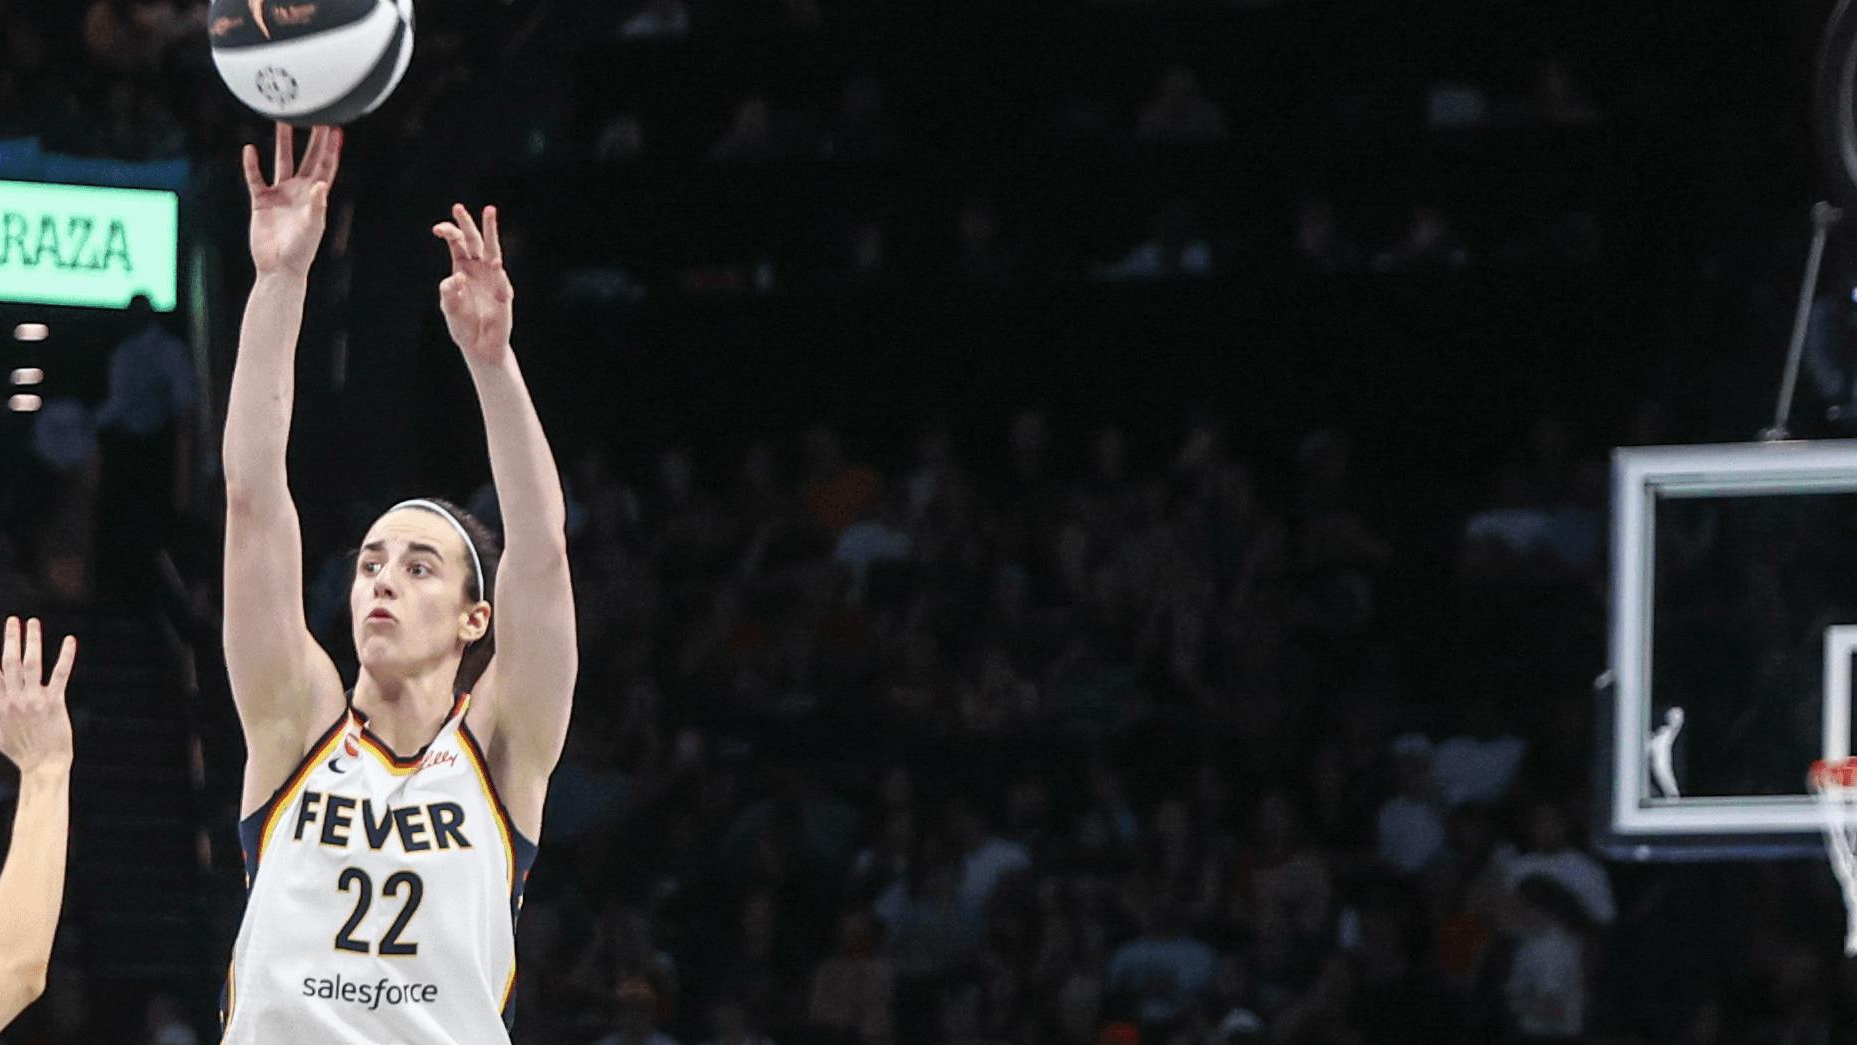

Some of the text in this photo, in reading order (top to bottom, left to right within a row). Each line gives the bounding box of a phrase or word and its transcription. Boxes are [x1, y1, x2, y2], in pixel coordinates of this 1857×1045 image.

[293, 790, 472, 853] FEVER
[333, 866, 425, 957] 22
[302, 973, 439, 1010] salesforce
